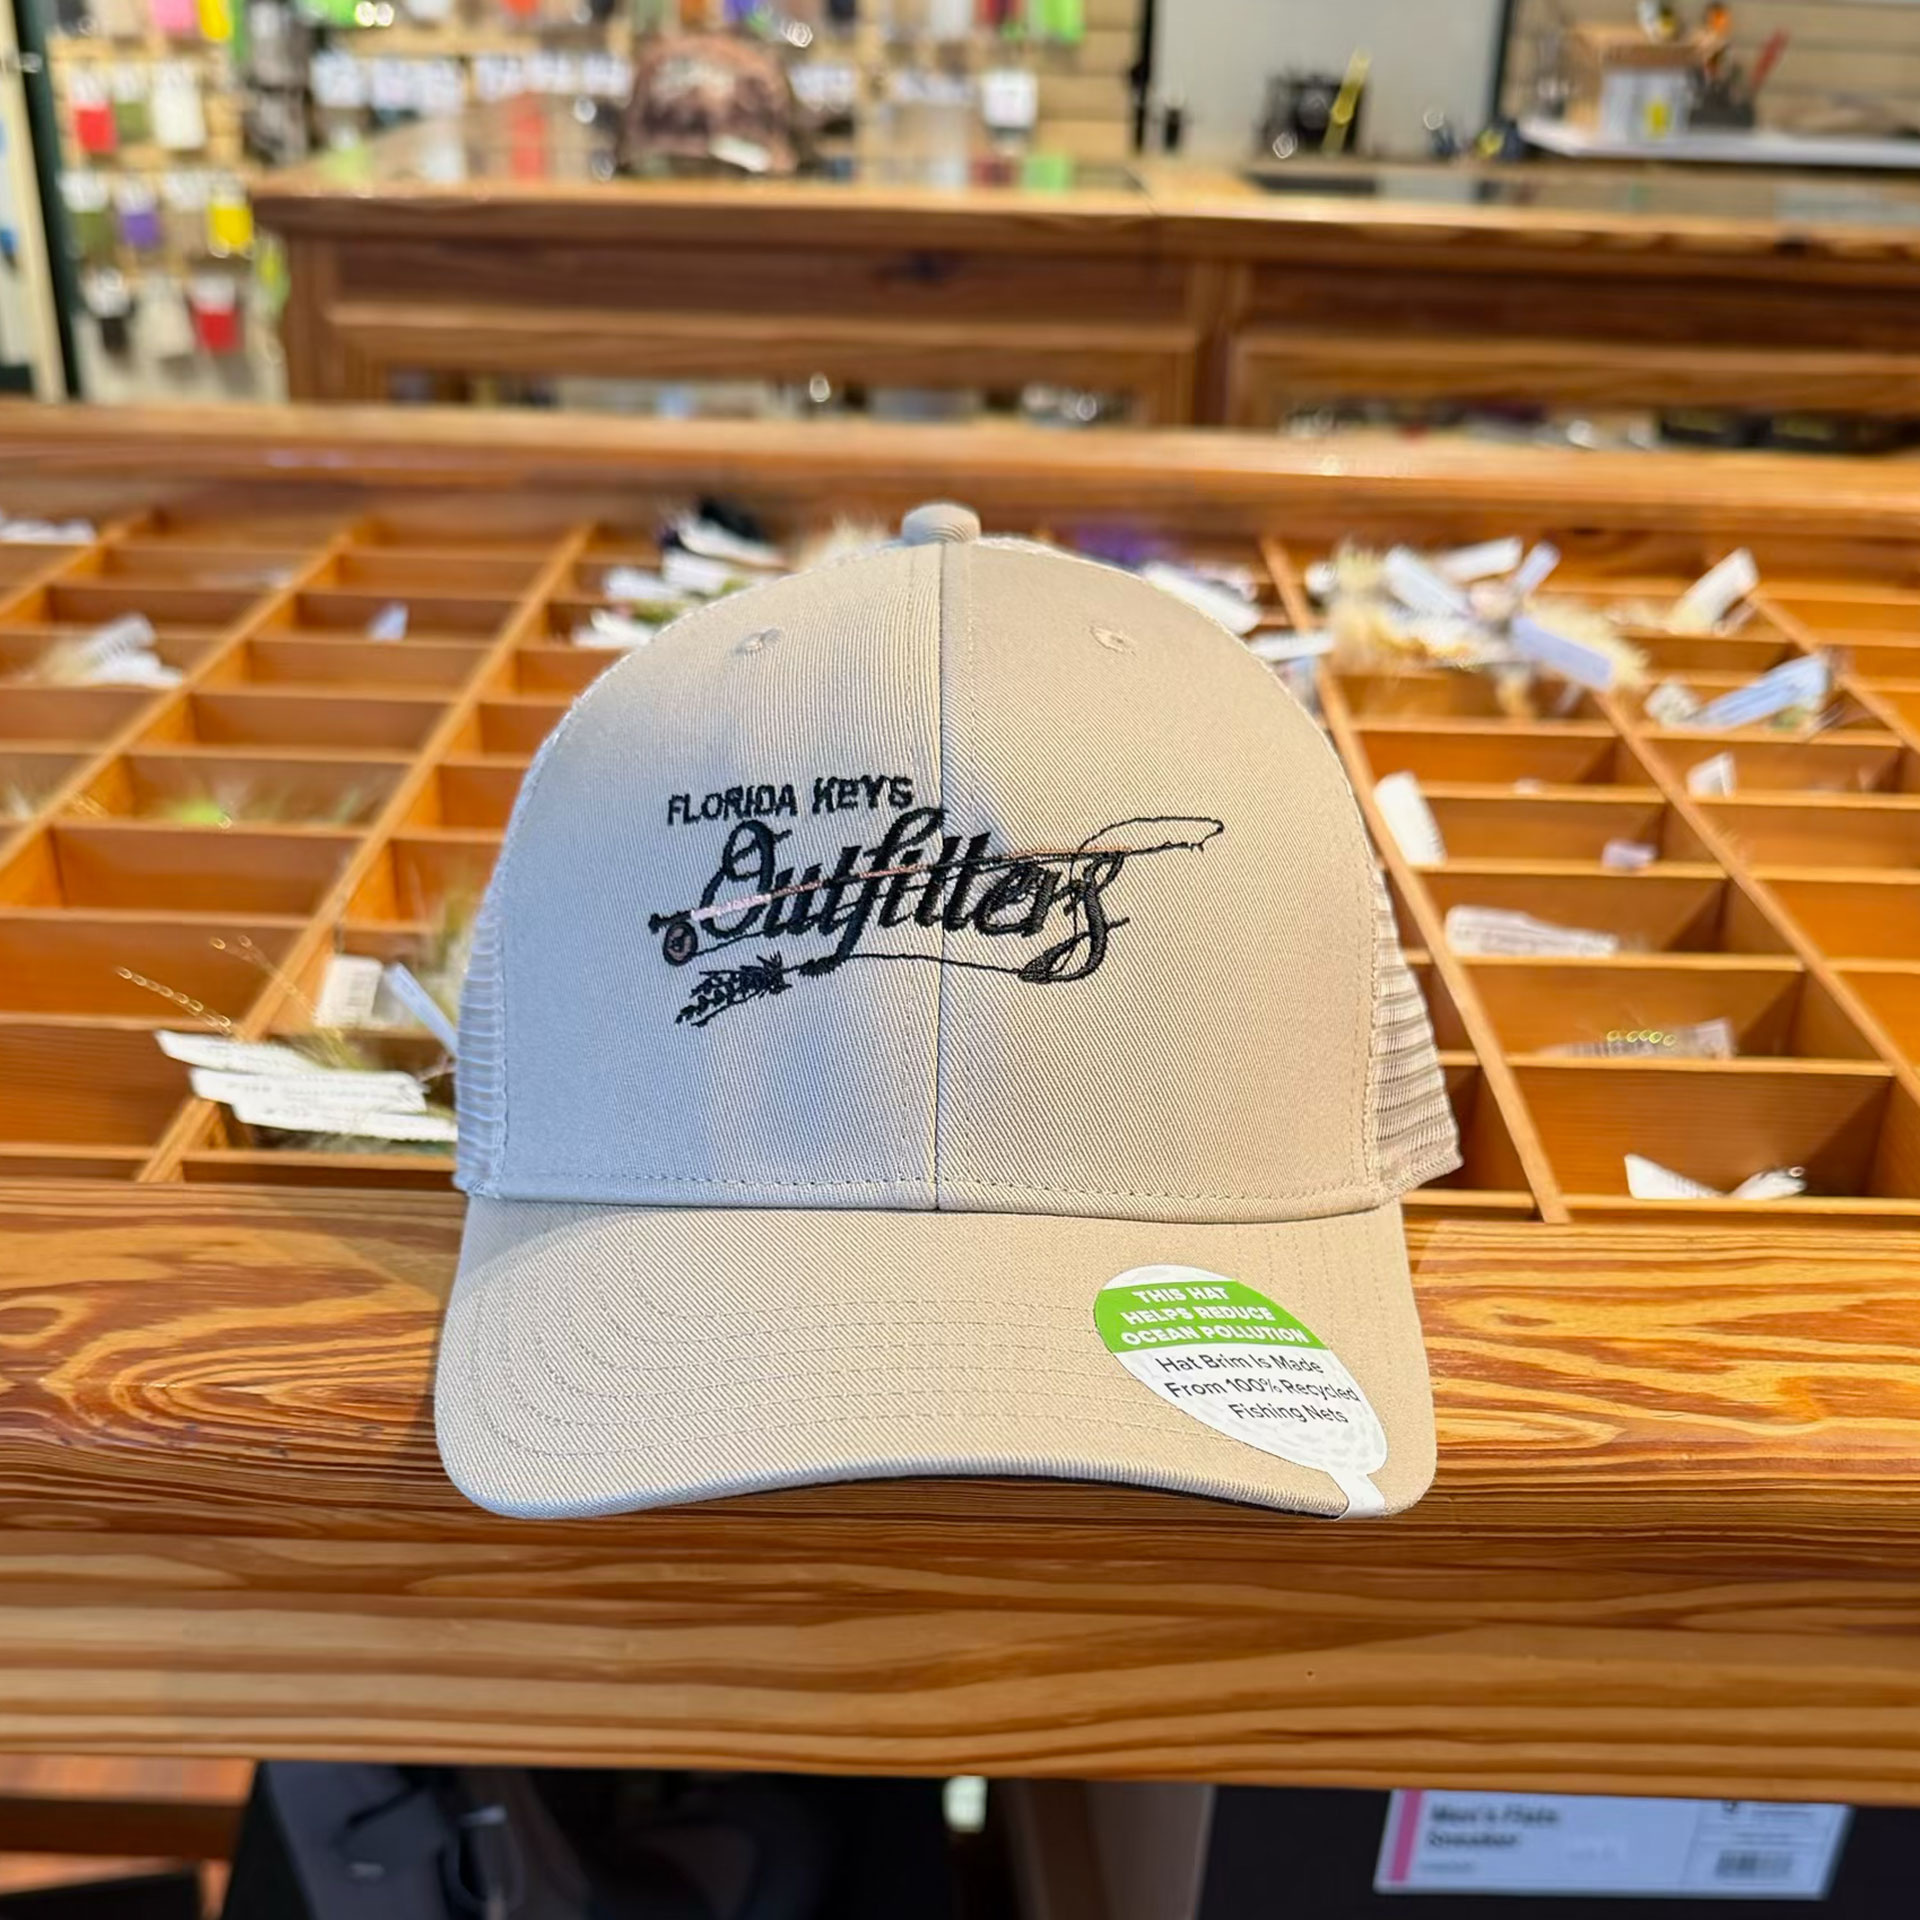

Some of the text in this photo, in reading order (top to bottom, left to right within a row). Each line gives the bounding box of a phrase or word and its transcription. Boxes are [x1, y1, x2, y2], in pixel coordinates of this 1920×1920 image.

[667, 776, 913, 825] FLORIDA KEYS
[700, 807, 1129, 984] Outfitters
[1132, 1287, 1229, 1303] THIS HAT
[1121, 1306, 1275, 1325] HELPS REDUCE
[1121, 1327, 1309, 1346] OCEAN POLLUTION
[1156, 1354, 1323, 1374] Hat Brim Is Made
[1165, 1378, 1360, 1402] From 100% Recycled
[1229, 1404, 1348, 1423] Fishing Nets
